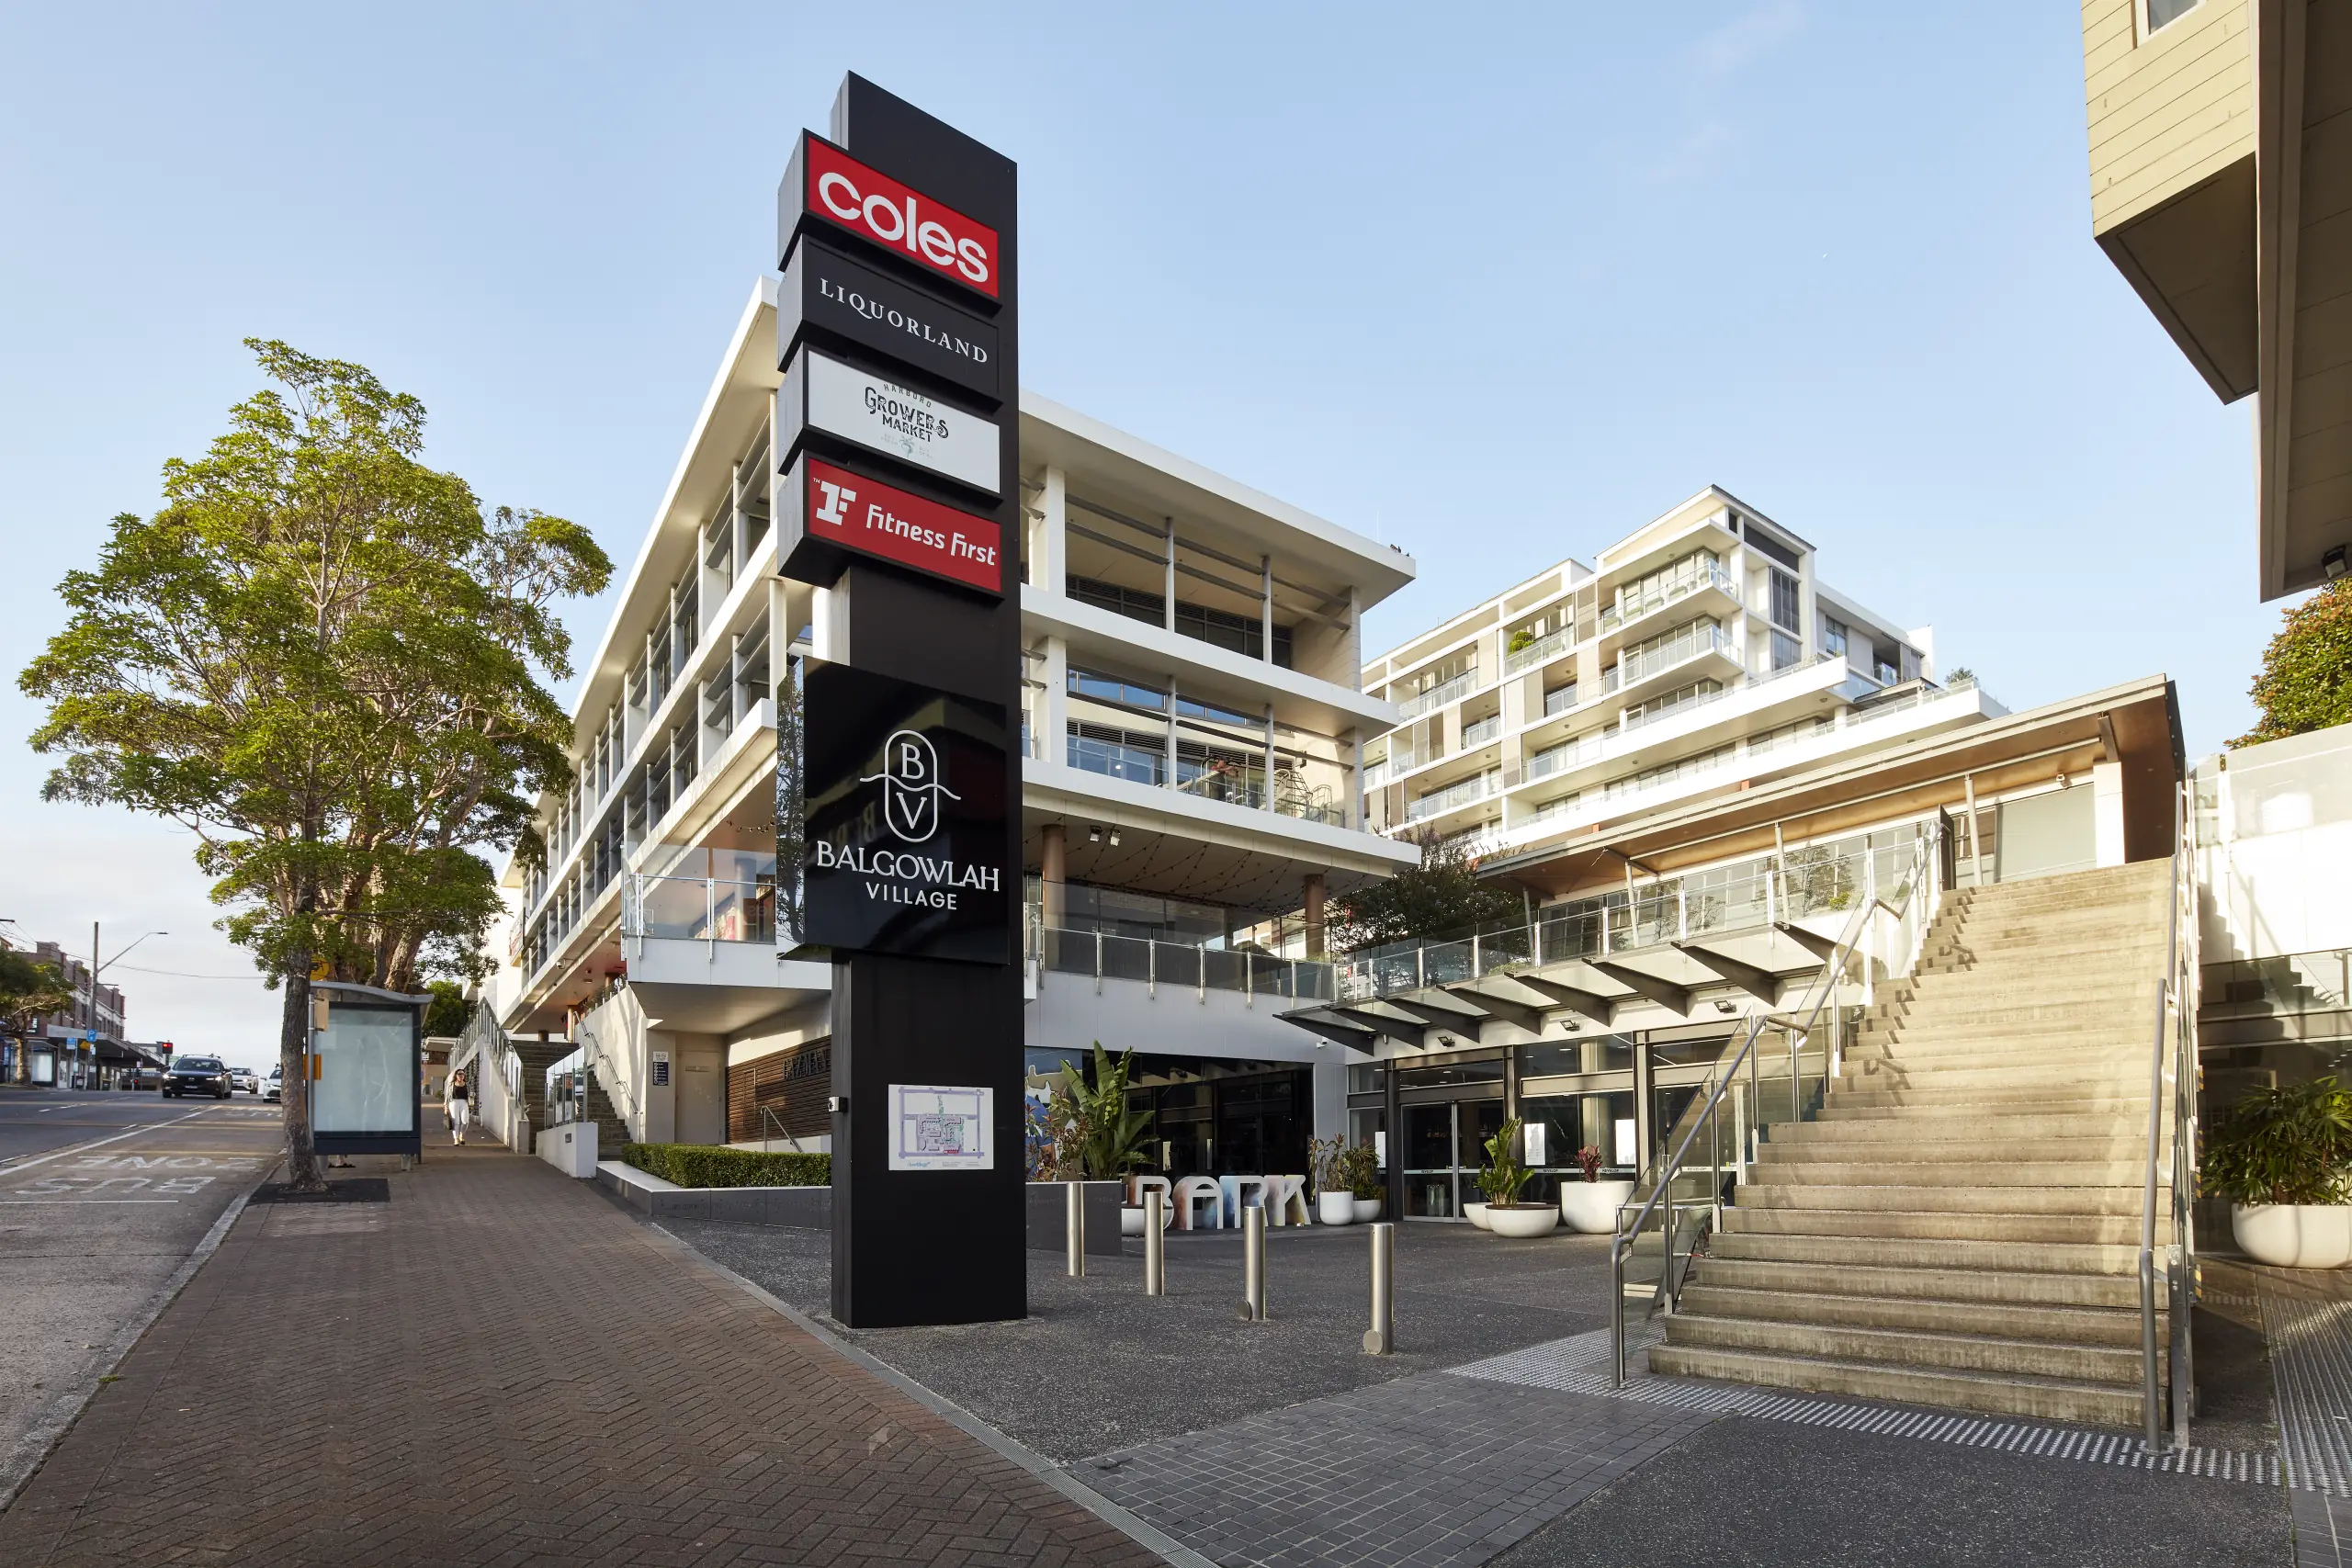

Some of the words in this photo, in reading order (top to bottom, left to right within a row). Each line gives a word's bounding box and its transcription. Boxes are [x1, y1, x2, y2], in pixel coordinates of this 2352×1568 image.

[819, 172, 989, 283] coles
[820, 277, 988, 363] LIQUORLAND
[865, 386, 949, 439] GROWERS
[882, 413, 933, 442] MARKET
[866, 503, 945, 549] Fitness
[950, 532, 997, 566] First
[900, 742, 925, 779] B
[896, 792, 928, 829] V
[817, 840, 1000, 892] BALGOWLAH
[865, 881, 957, 910] VILLAGE
[16, 1177, 216, 1194] BUS
